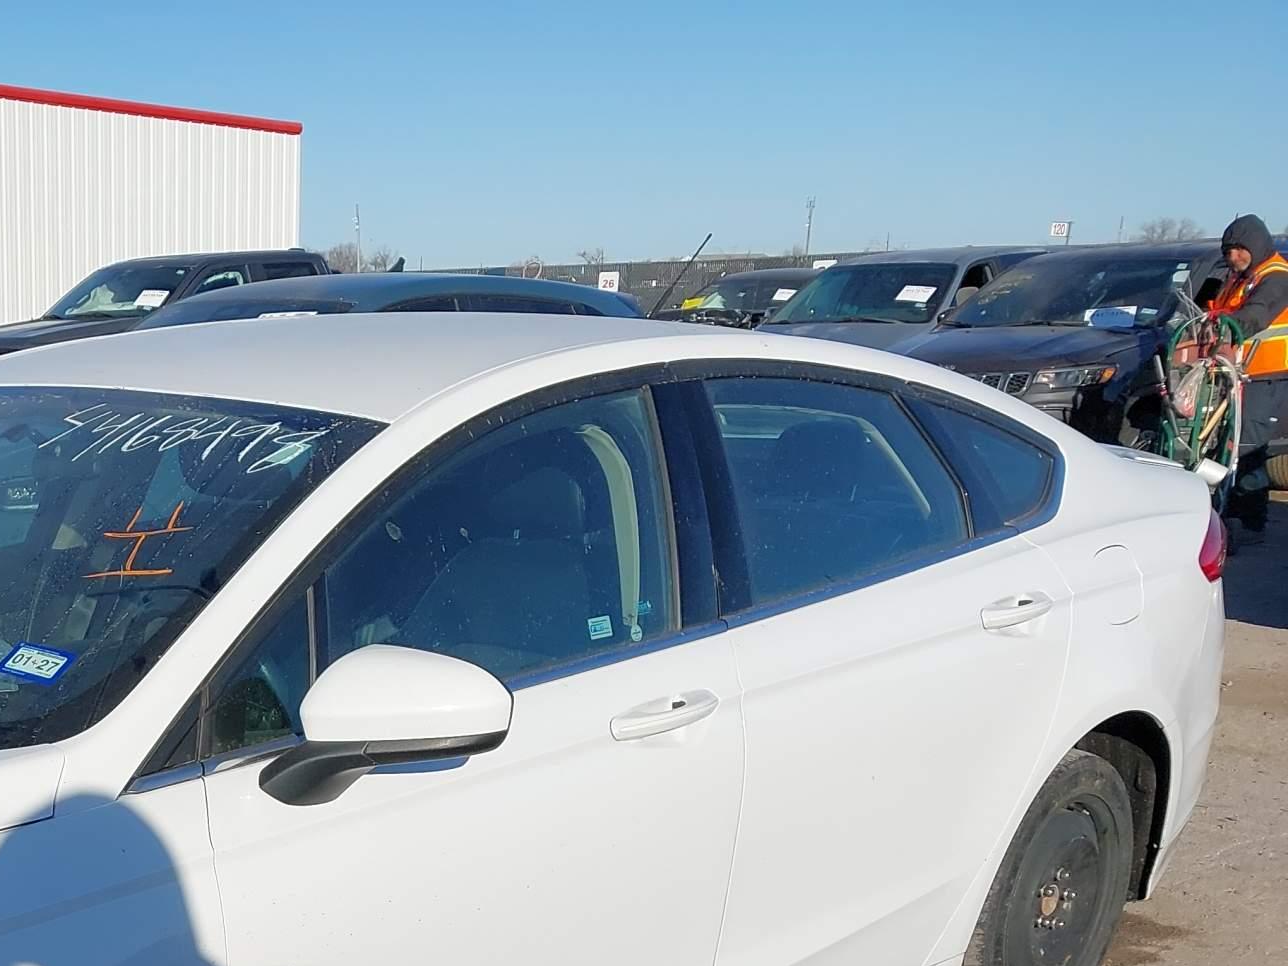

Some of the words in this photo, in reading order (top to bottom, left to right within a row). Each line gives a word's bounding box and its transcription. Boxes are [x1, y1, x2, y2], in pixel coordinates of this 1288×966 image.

[1053, 223, 1065, 235] 120
[601, 279, 615, 289] 26
[35, 659, 61, 673] 27
